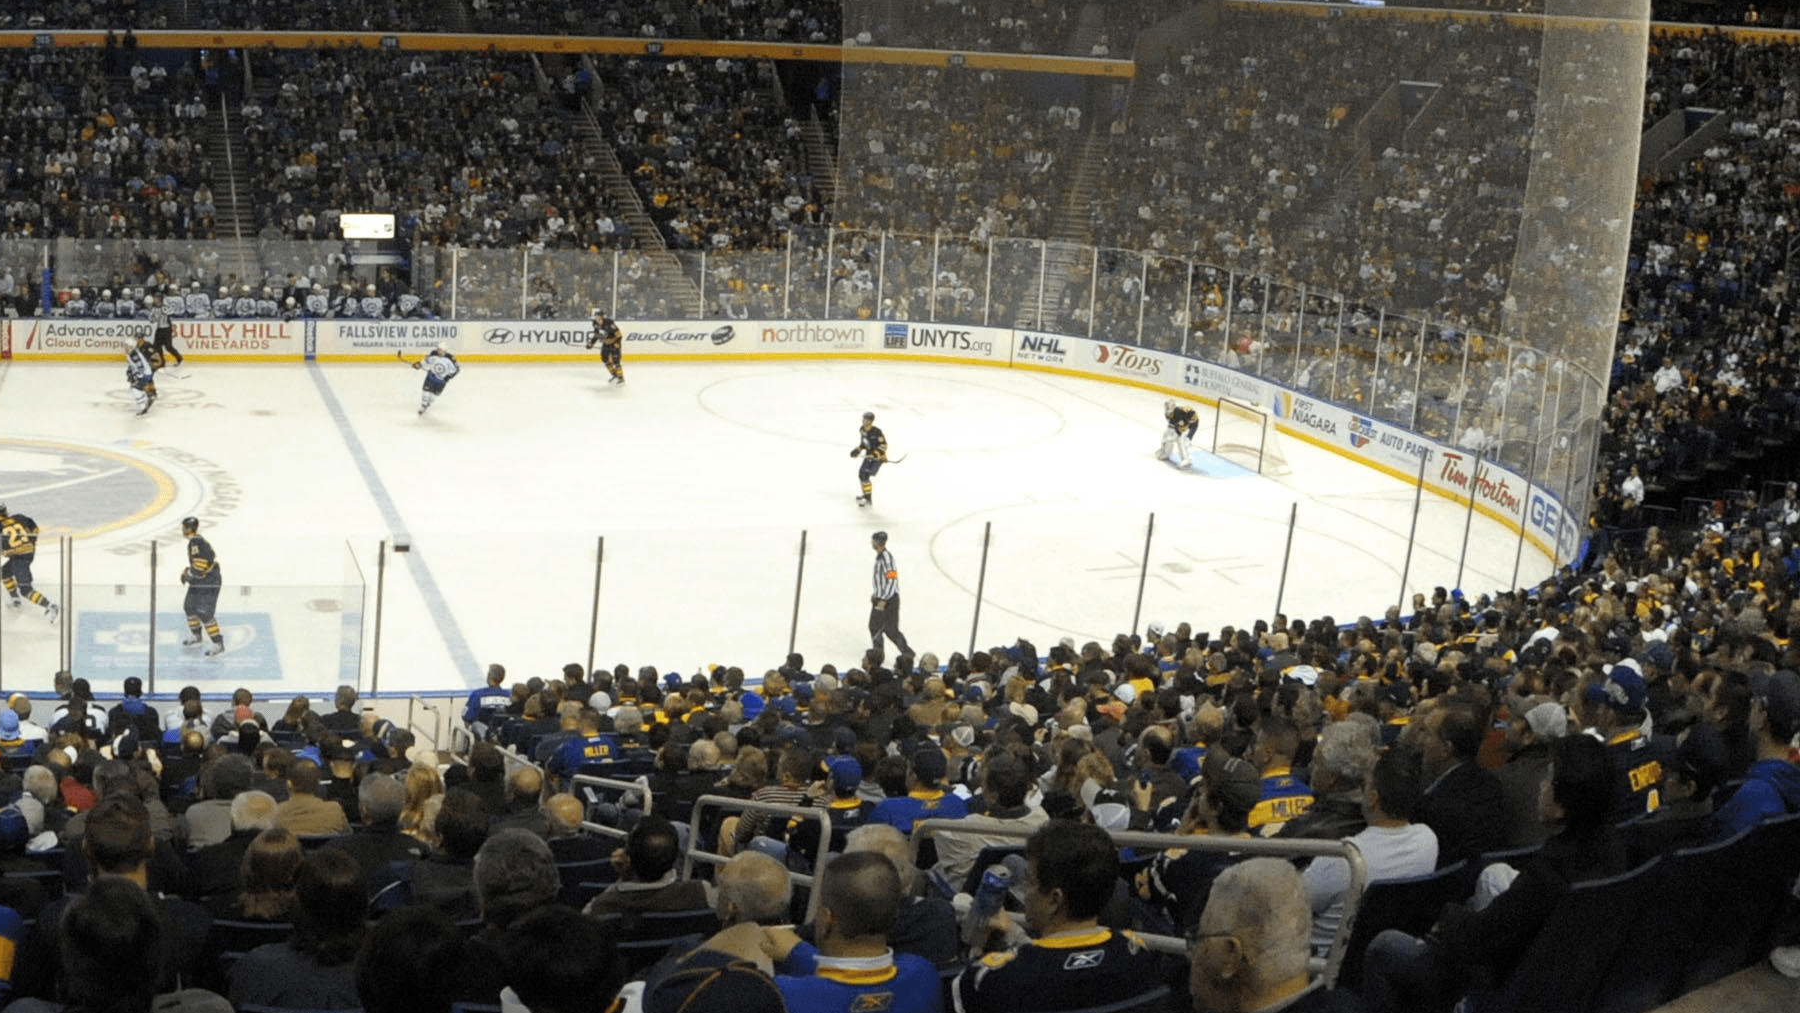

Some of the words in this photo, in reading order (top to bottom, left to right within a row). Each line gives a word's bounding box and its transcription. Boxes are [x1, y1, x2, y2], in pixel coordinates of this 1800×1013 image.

[171, 323, 235, 339] BULLY
[242, 323, 291, 339] HILL
[339, 325, 407, 338] FALLSVIEW
[412, 325, 457, 338] CASINO
[762, 322, 864, 342] northtown
[45, 337, 81, 348] Cloud
[186, 339, 270, 349] VINEYARDS
[912, 328, 992, 356] UNYTS.org
[1020, 335, 1066, 355] NHL
[1017, 352, 1063, 363] NETWORK
[1292, 408, 1336, 436] NIAGARA
[1380, 432, 1404, 451] AUTO
[1441, 452, 1468, 489] Tim
[1469, 462, 1520, 515] Hortons
